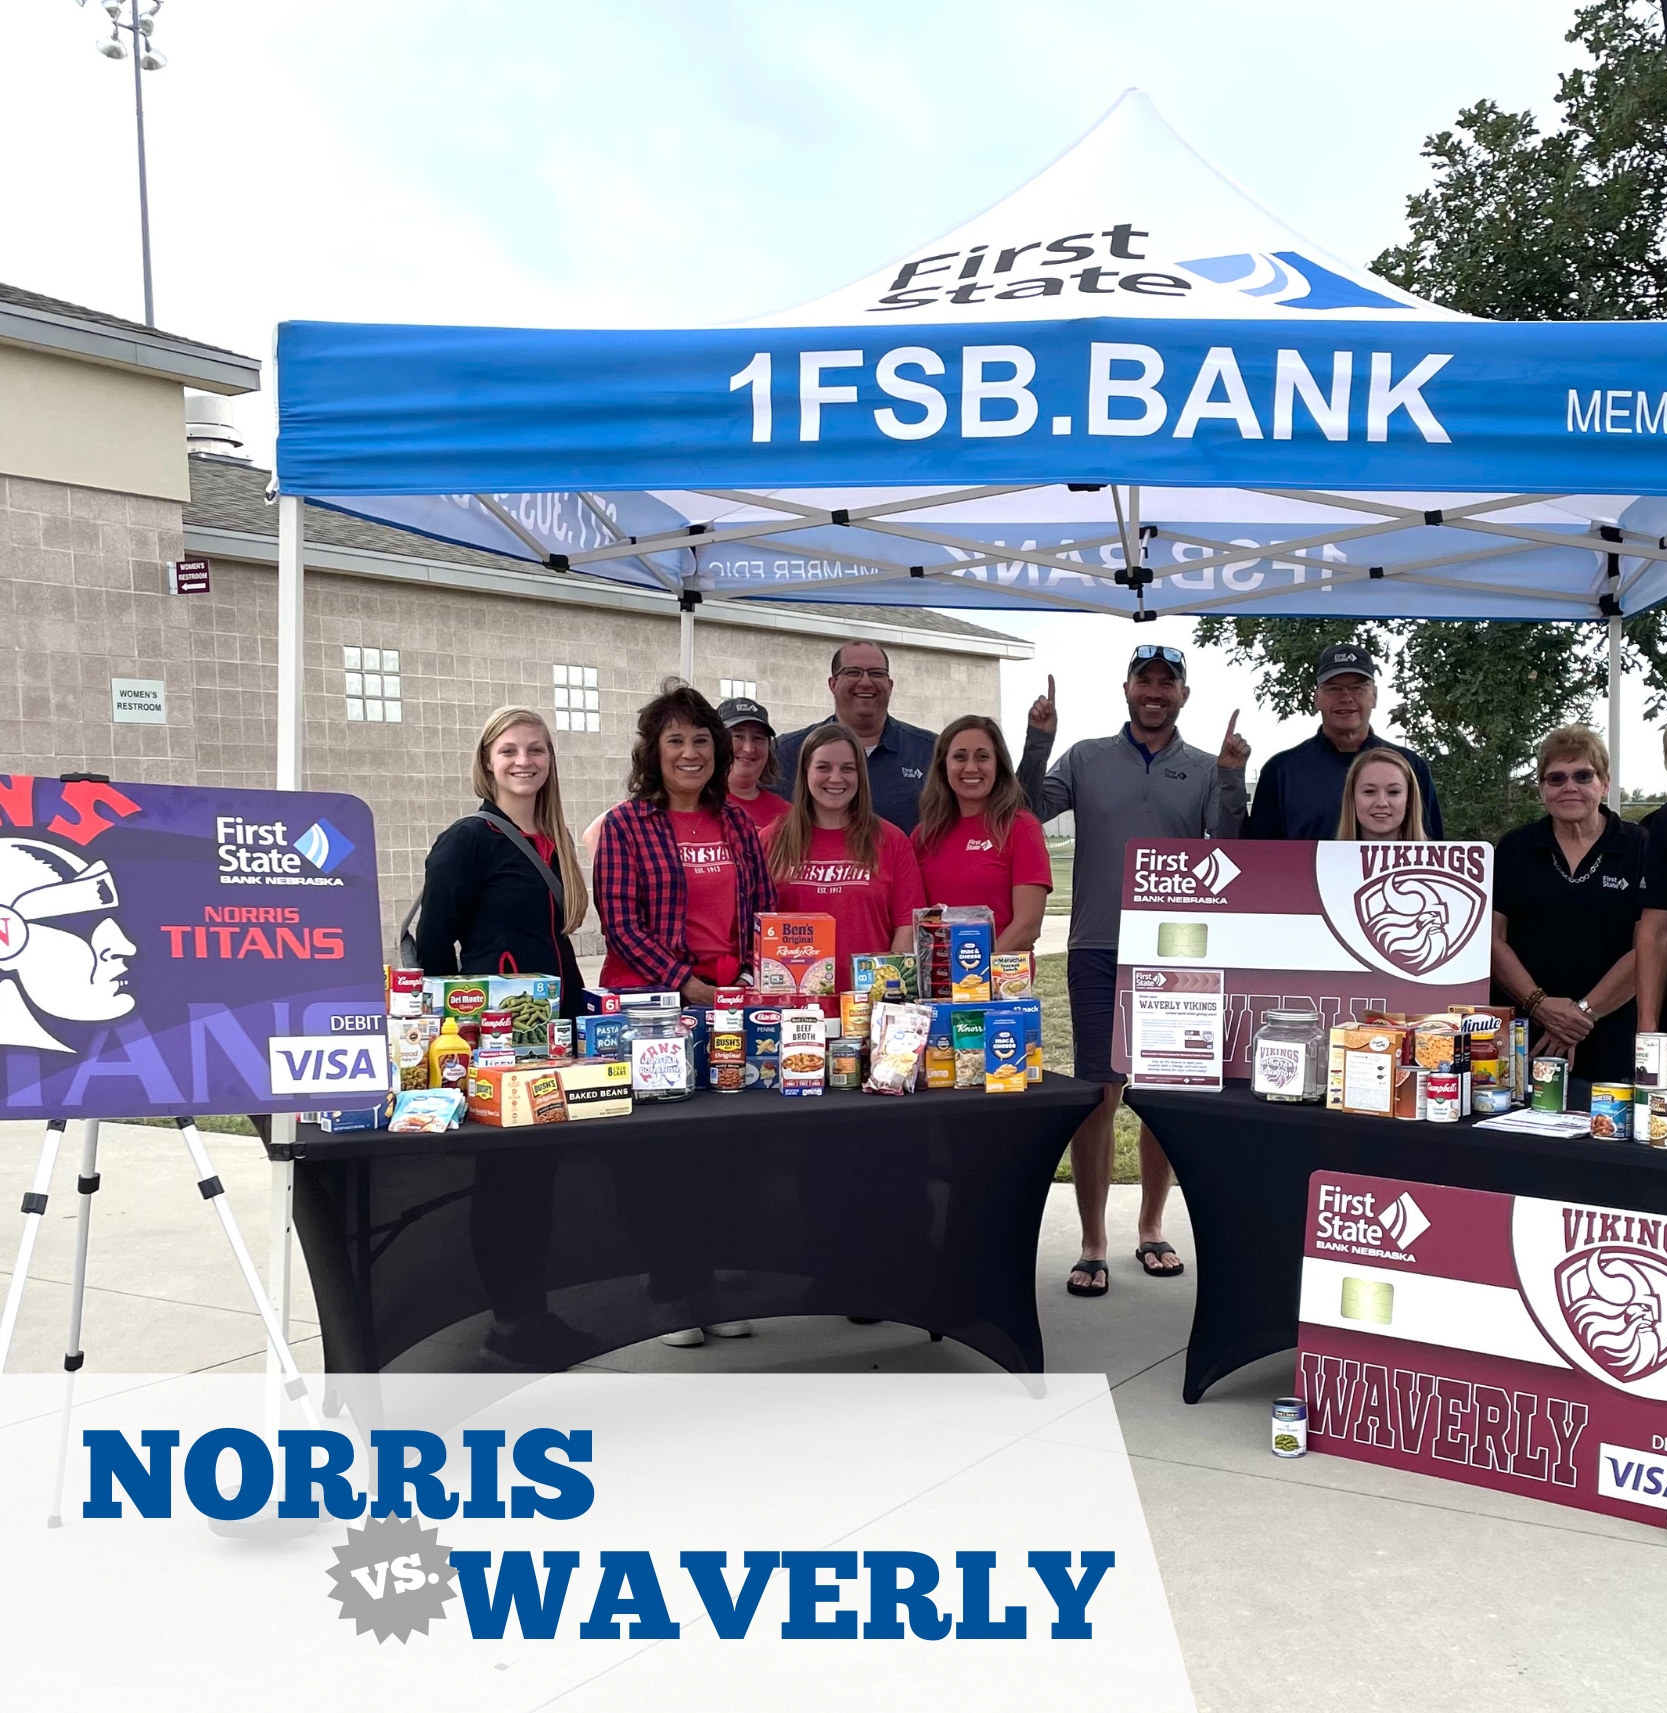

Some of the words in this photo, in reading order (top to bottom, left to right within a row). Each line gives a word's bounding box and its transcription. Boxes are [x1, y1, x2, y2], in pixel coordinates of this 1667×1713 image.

[890, 223, 1150, 291] First
[867, 265, 1193, 314] State
[730, 342, 1454, 444] 1FSB.BANK
[180, 562, 205, 571] WOMEN'S
[178, 572, 208, 581] RESTROOM
[119, 689, 158, 699] WOMEN'S
[117, 702, 162, 712] RESTROOM
[217, 816, 287, 846] First
[218, 845, 301, 875] State
[1135, 848, 1189, 873] First
[1360, 845, 1486, 884] VIKINGS
[220, 875, 263, 886] BANK
[265, 876, 345, 887] NEBRASKA
[1134, 871, 1197, 895] State
[1133, 895, 1165, 903] BANK
[1167, 896, 1229, 905] NEBRASKA
[204, 906, 300, 924] NORRIS
[767, 926, 775, 936] 6
[782, 923, 814, 935] Ben's
[160, 925, 346, 960] TITANS
[782, 935, 814, 944] Original
[1136, 973, 1152, 981] First
[1136, 980, 1155, 988] State
[450, 994, 461, 1004] Del
[463, 994, 484, 1004] Monte
[605, 1000, 614, 1011] 6
[1139, 1000, 1181, 1010] WAVERLY
[1183, 1001, 1217, 1011] VIKINGS
[330, 1014, 382, 1032] DEBIT
[756, 1013, 781, 1022] Barilla
[596, 1026, 619, 1035] PASTA
[796, 1024, 812, 1033] BEEF
[957, 1023, 983, 1033] Knorr
[715, 1038, 741, 1047] BUSH'S
[792, 1032, 816, 1041] BROTH
[1260, 1046, 1299, 1061] VIKINGS
[275, 1048, 377, 1081] VISA
[534, 1079, 557, 1093] BUSH'S
[569, 1090, 598, 1101] BAKED
[600, 1087, 629, 1098] BEANS
[1319, 1184, 1376, 1218] First
[1316, 1211, 1383, 1246] State
[1316, 1240, 1349, 1254] BANK
[1351, 1245, 1416, 1263] NEBRASKA
[1300, 1351, 1589, 1488] WAVERLY
